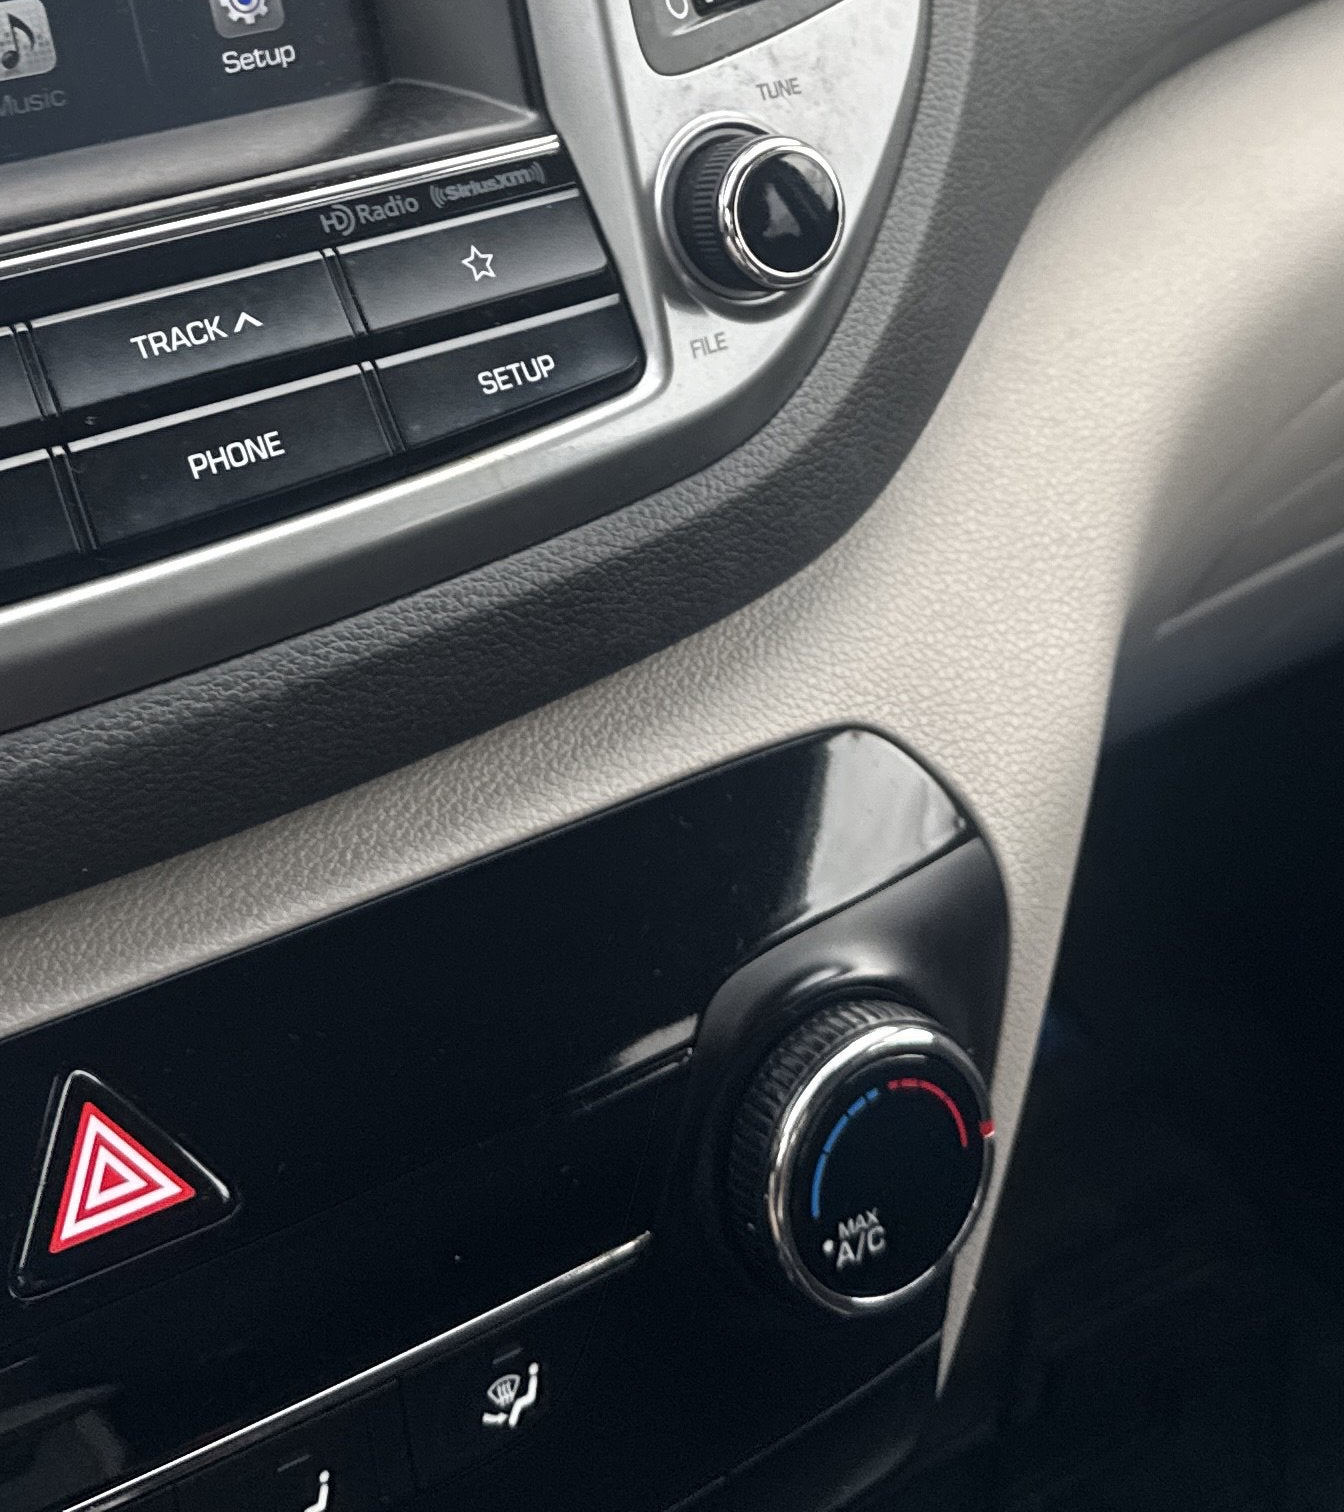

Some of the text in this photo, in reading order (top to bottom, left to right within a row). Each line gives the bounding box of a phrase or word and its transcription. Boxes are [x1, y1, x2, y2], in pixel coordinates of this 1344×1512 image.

[222, 44, 296, 74] Setup
[756, 76, 803, 102] TUNE
[357, 195, 419, 225] Radio
[130, 316, 228, 360] TRACK
[690, 331, 729, 359] FILE
[478, 354, 555, 395] SETUP
[187, 430, 286, 479] PHONE
[838, 1207, 880, 1240] MAX
[836, 1225, 886, 1269] A/C
